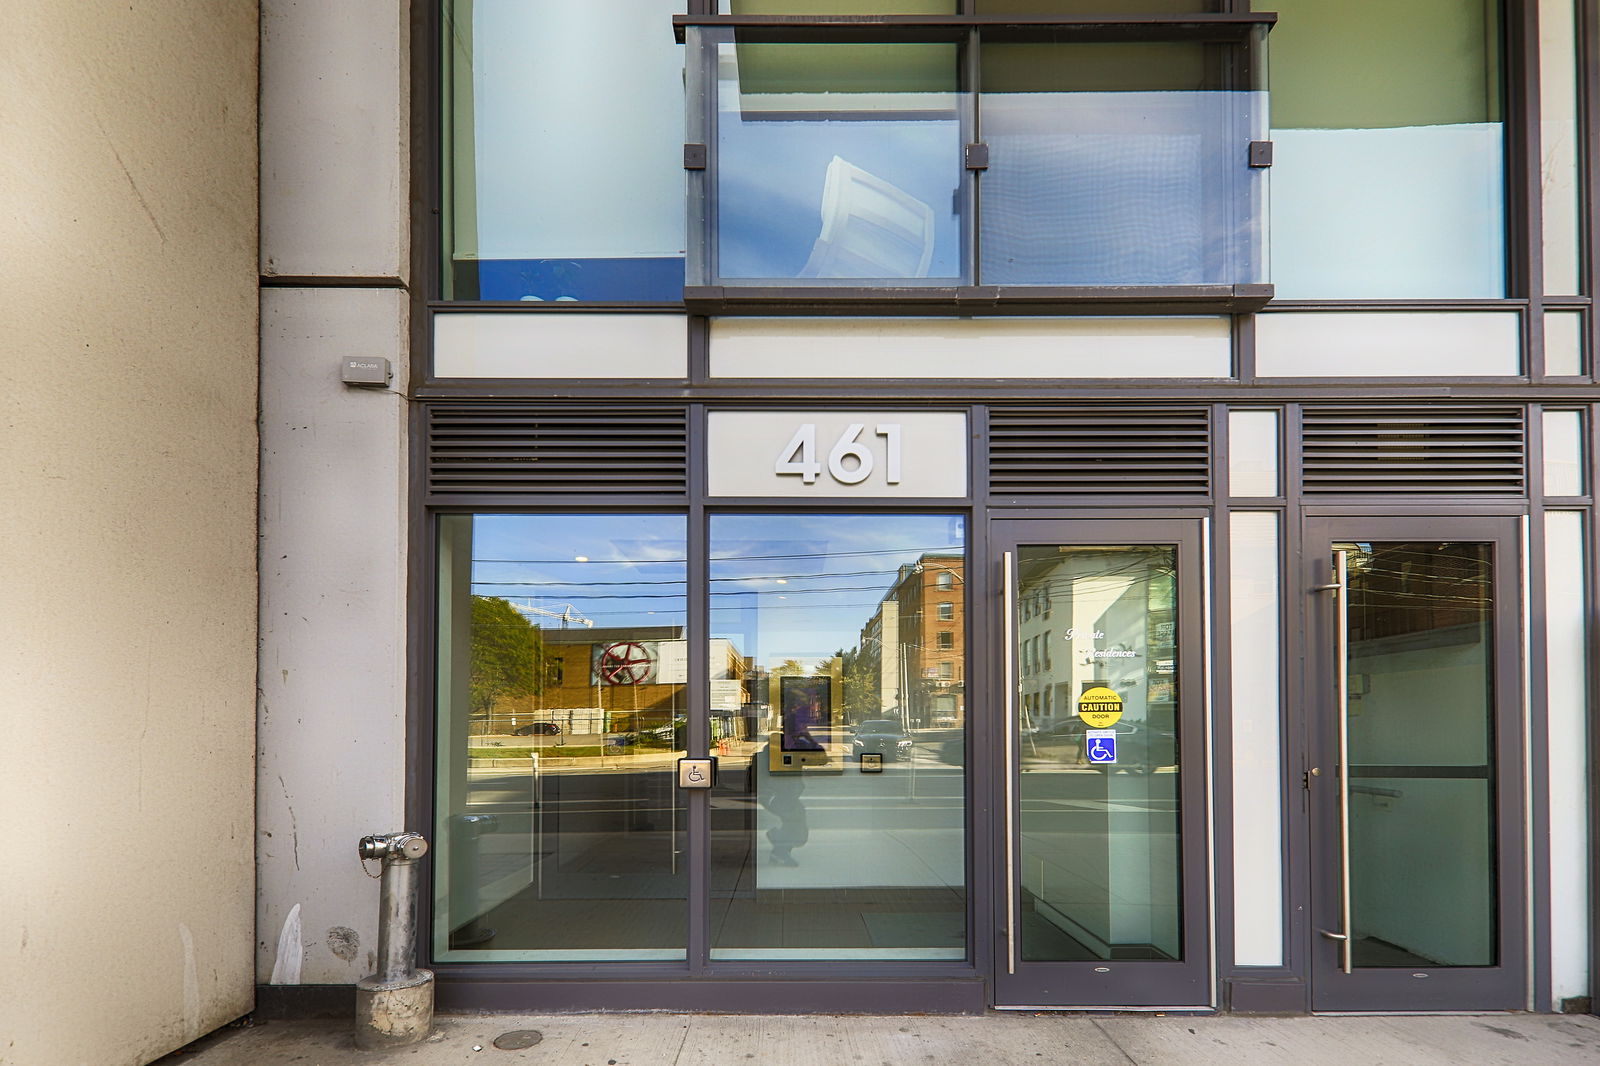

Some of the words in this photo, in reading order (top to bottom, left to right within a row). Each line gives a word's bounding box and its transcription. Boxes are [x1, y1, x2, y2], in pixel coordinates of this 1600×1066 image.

[775, 423, 901, 485] 461
[1064, 627, 1105, 641] Pate
[1083, 646, 1136, 658] esidences
[1081, 703, 1120, 712] CAUTION
